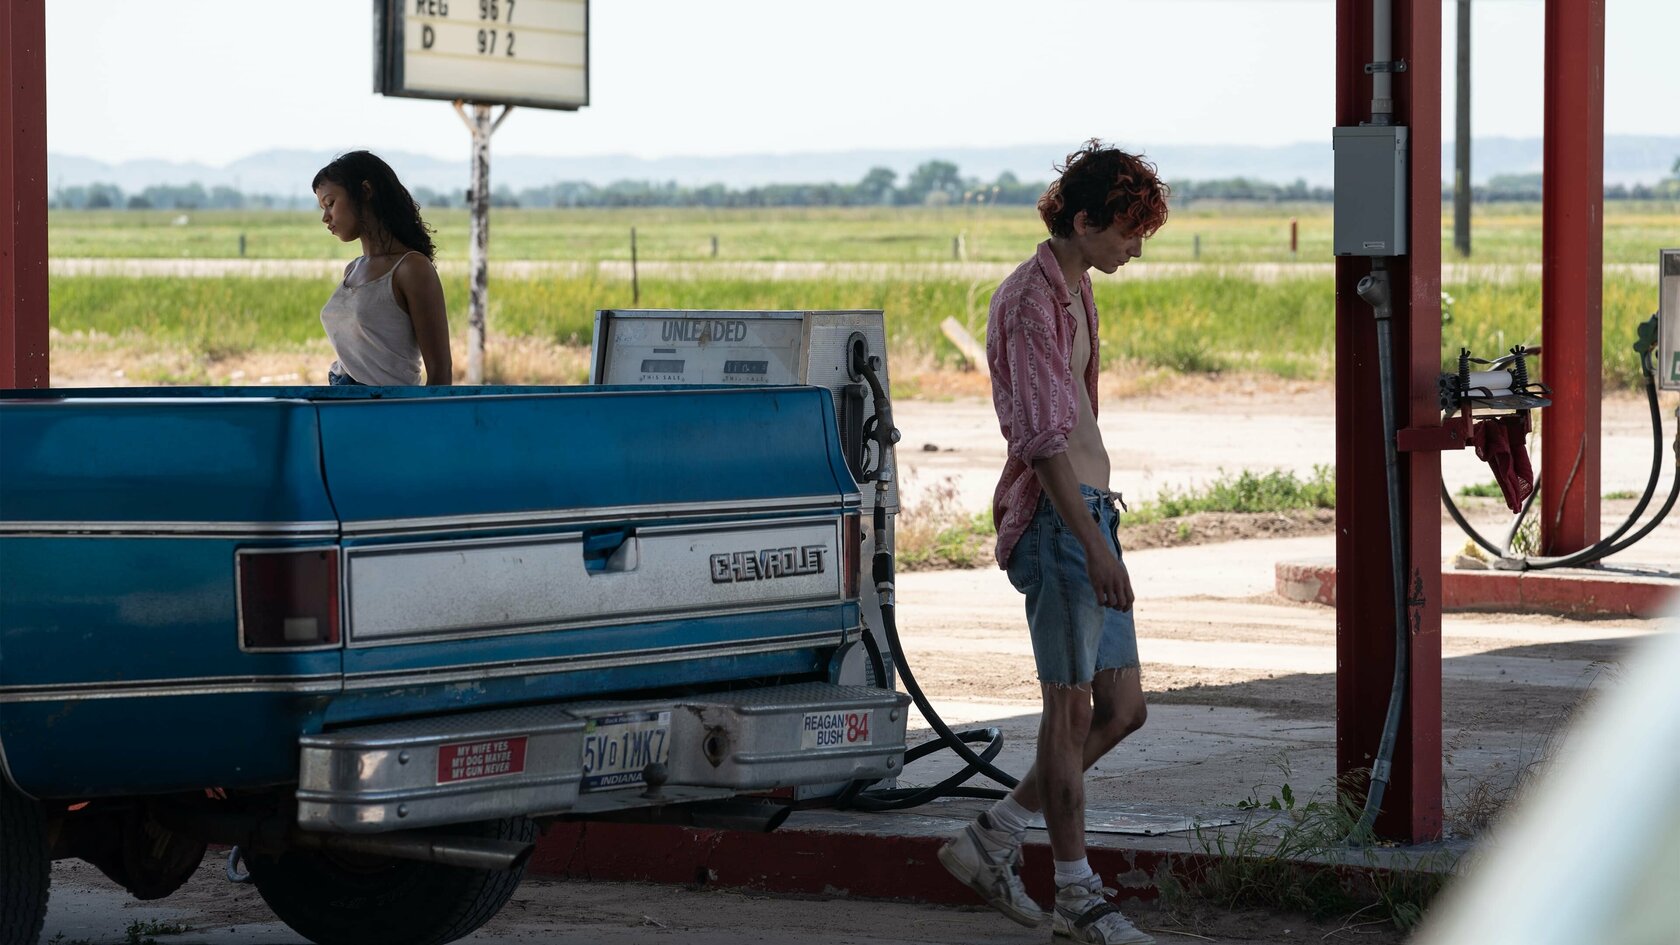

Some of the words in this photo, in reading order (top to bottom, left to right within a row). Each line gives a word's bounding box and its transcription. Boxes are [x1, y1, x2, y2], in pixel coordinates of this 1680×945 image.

[416, 0, 448, 16] REG
[506, 0, 515, 23] 7
[422, 24, 435, 49] D
[478, 29, 496, 54] 97
[506, 31, 515, 57] 2
[661, 320, 748, 342] UNLEADED
[710, 545, 827, 584] CHEVROLET
[804, 713, 845, 731] REAGAN
[845, 712, 869, 742] '84
[817, 730, 844, 745] BUSH
[457, 746, 470, 757] MY
[472, 743, 492, 754] WIFE
[493, 741, 509, 752] YES
[452, 757, 464, 768] MY
[466, 755, 483, 766] DOG
[485, 751, 512, 764] MAYBE
[451, 767, 464, 779] MY
[465, 766, 483, 777] GUN
[484, 762, 511, 774] NEVER
[601, 772, 643, 786] INDIANA
